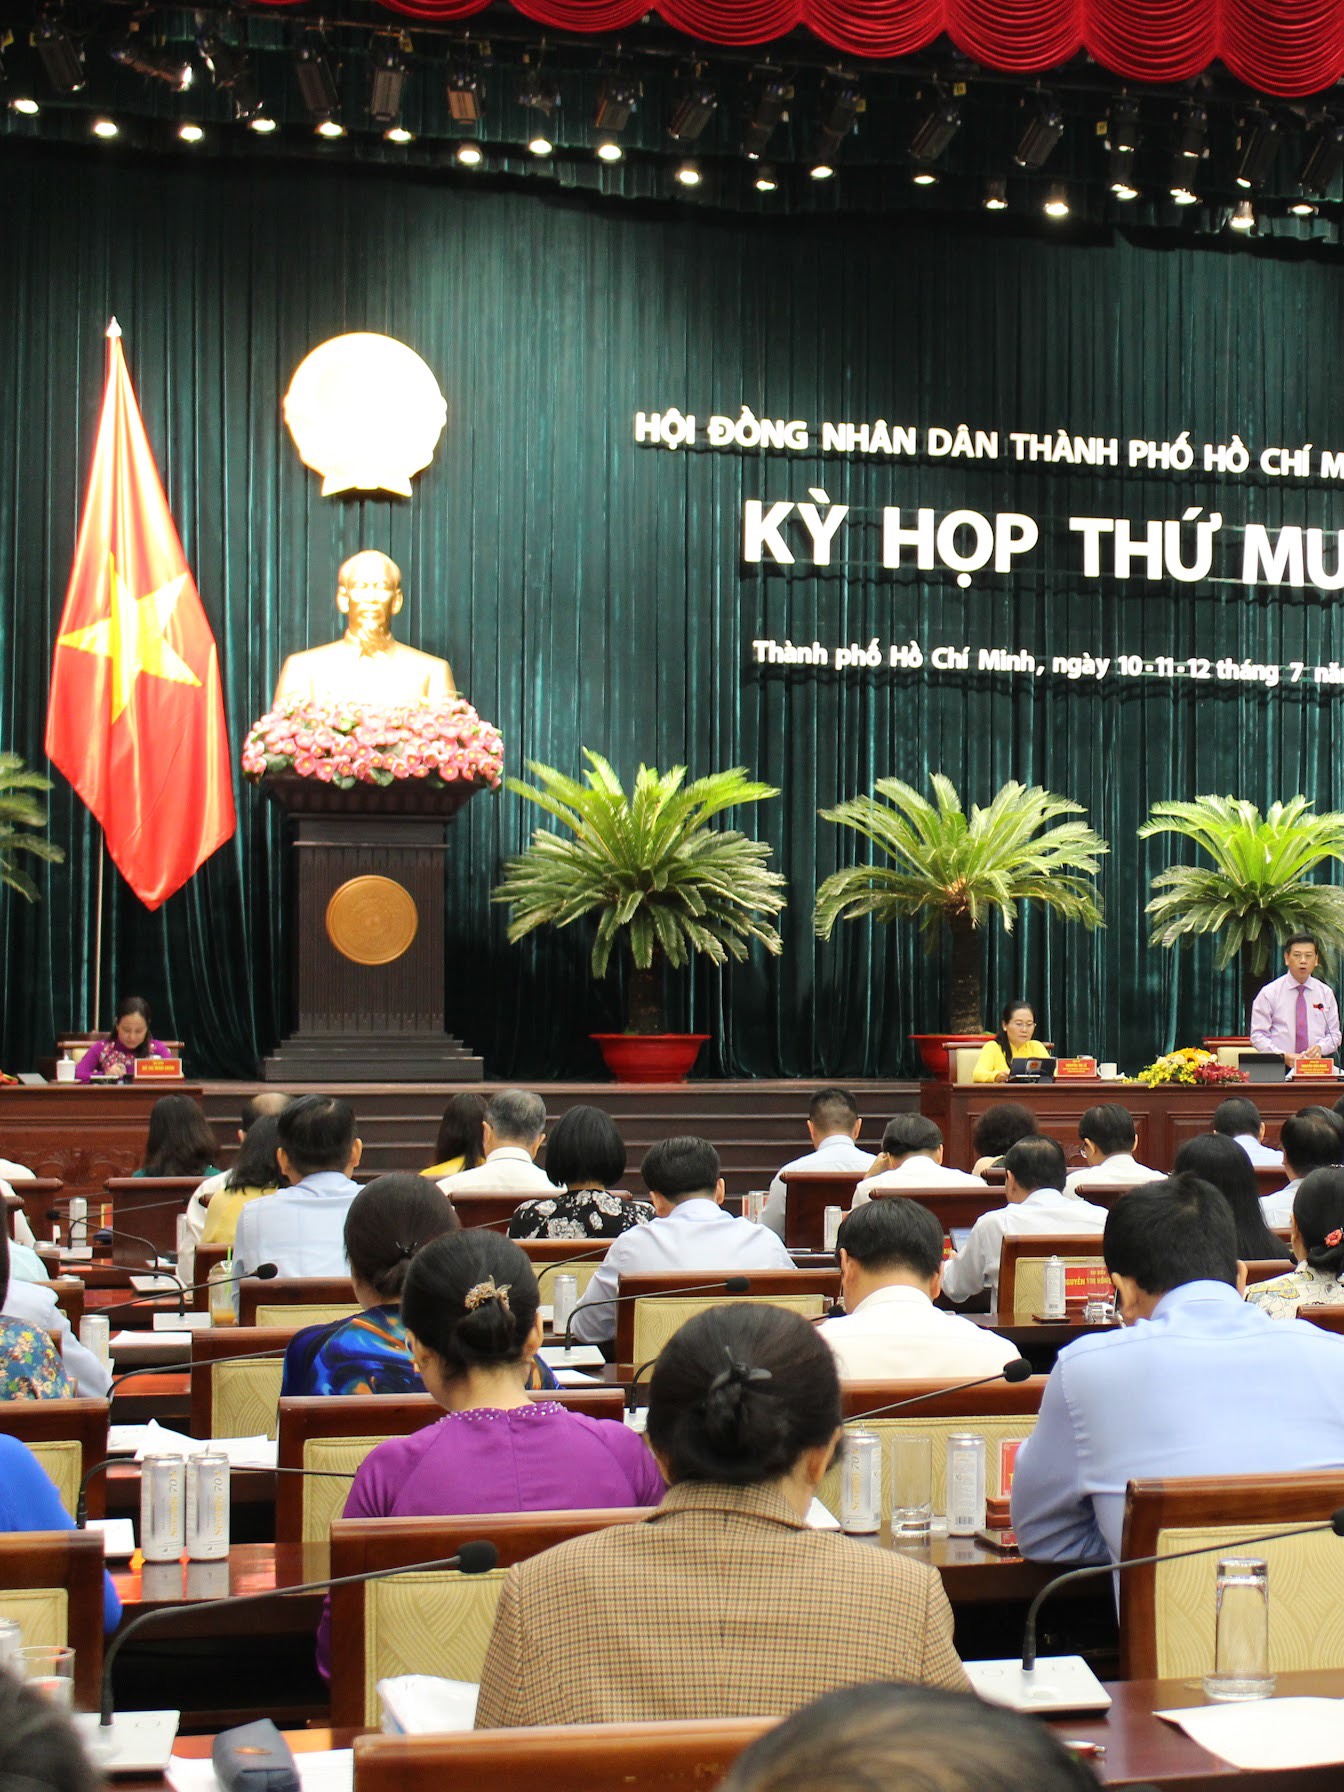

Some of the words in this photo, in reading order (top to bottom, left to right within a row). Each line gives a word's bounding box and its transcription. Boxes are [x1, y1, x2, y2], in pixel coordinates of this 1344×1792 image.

[635, 408, 696, 450] HỘI
[707, 406, 809, 450] ĐỒNG
[823, 420, 917, 456] NHÂN
[928, 424, 998, 459] DÂN
[1010, 430, 1118, 466] THÀNH
[1129, 432, 1194, 471] PHỐ
[1204, 435, 1250, 474] HỒ
[1260, 444, 1313, 477] CHÍ
[744, 488, 850, 566] KỲ
[883, 507, 1039, 589] HỌP
[1070, 507, 1223, 582] THỨ
[753, 640, 828, 665] Thành
[835, 638, 882, 670] phố
[890, 641, 924, 669] Hồ
[932, 647, 971, 670] Chí
[979, 649, 1045, 677] Minh,
[1053, 653, 1111, 680] ngày
[1216, 658, 1280, 687] tháng
[1289, 662, 1304, 683] 7
[1065, 1276, 1086, 1286] GUYỄN
